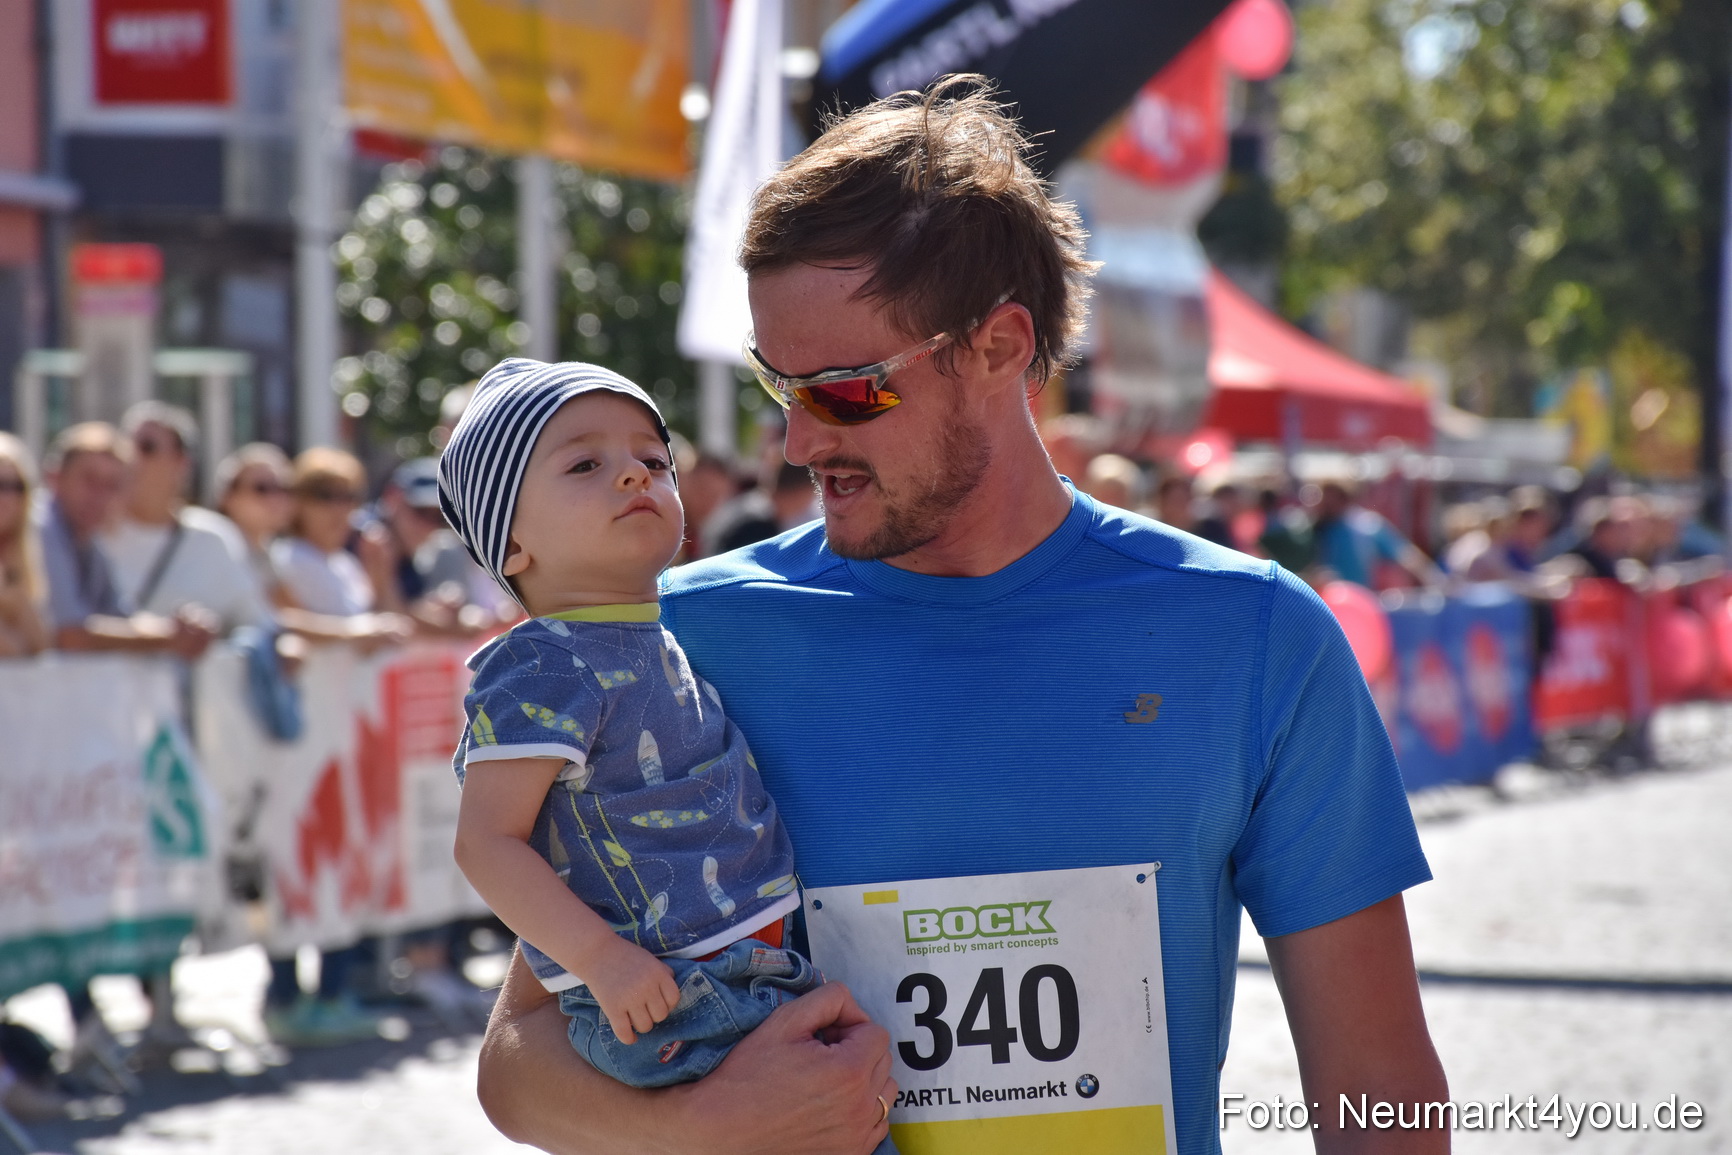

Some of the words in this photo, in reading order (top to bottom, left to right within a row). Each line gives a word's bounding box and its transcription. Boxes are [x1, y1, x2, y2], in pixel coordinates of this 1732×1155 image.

[903, 900, 1057, 943] BOCK
[906, 943, 950, 956] inspired
[954, 942, 967, 953] by
[971, 940, 1004, 951] smart
[1007, 937, 1059, 949] concepts
[896, 964, 1080, 1071] 340
[894, 1087, 961, 1108] PARTL
[966, 1081, 1067, 1103] Neumarkt
